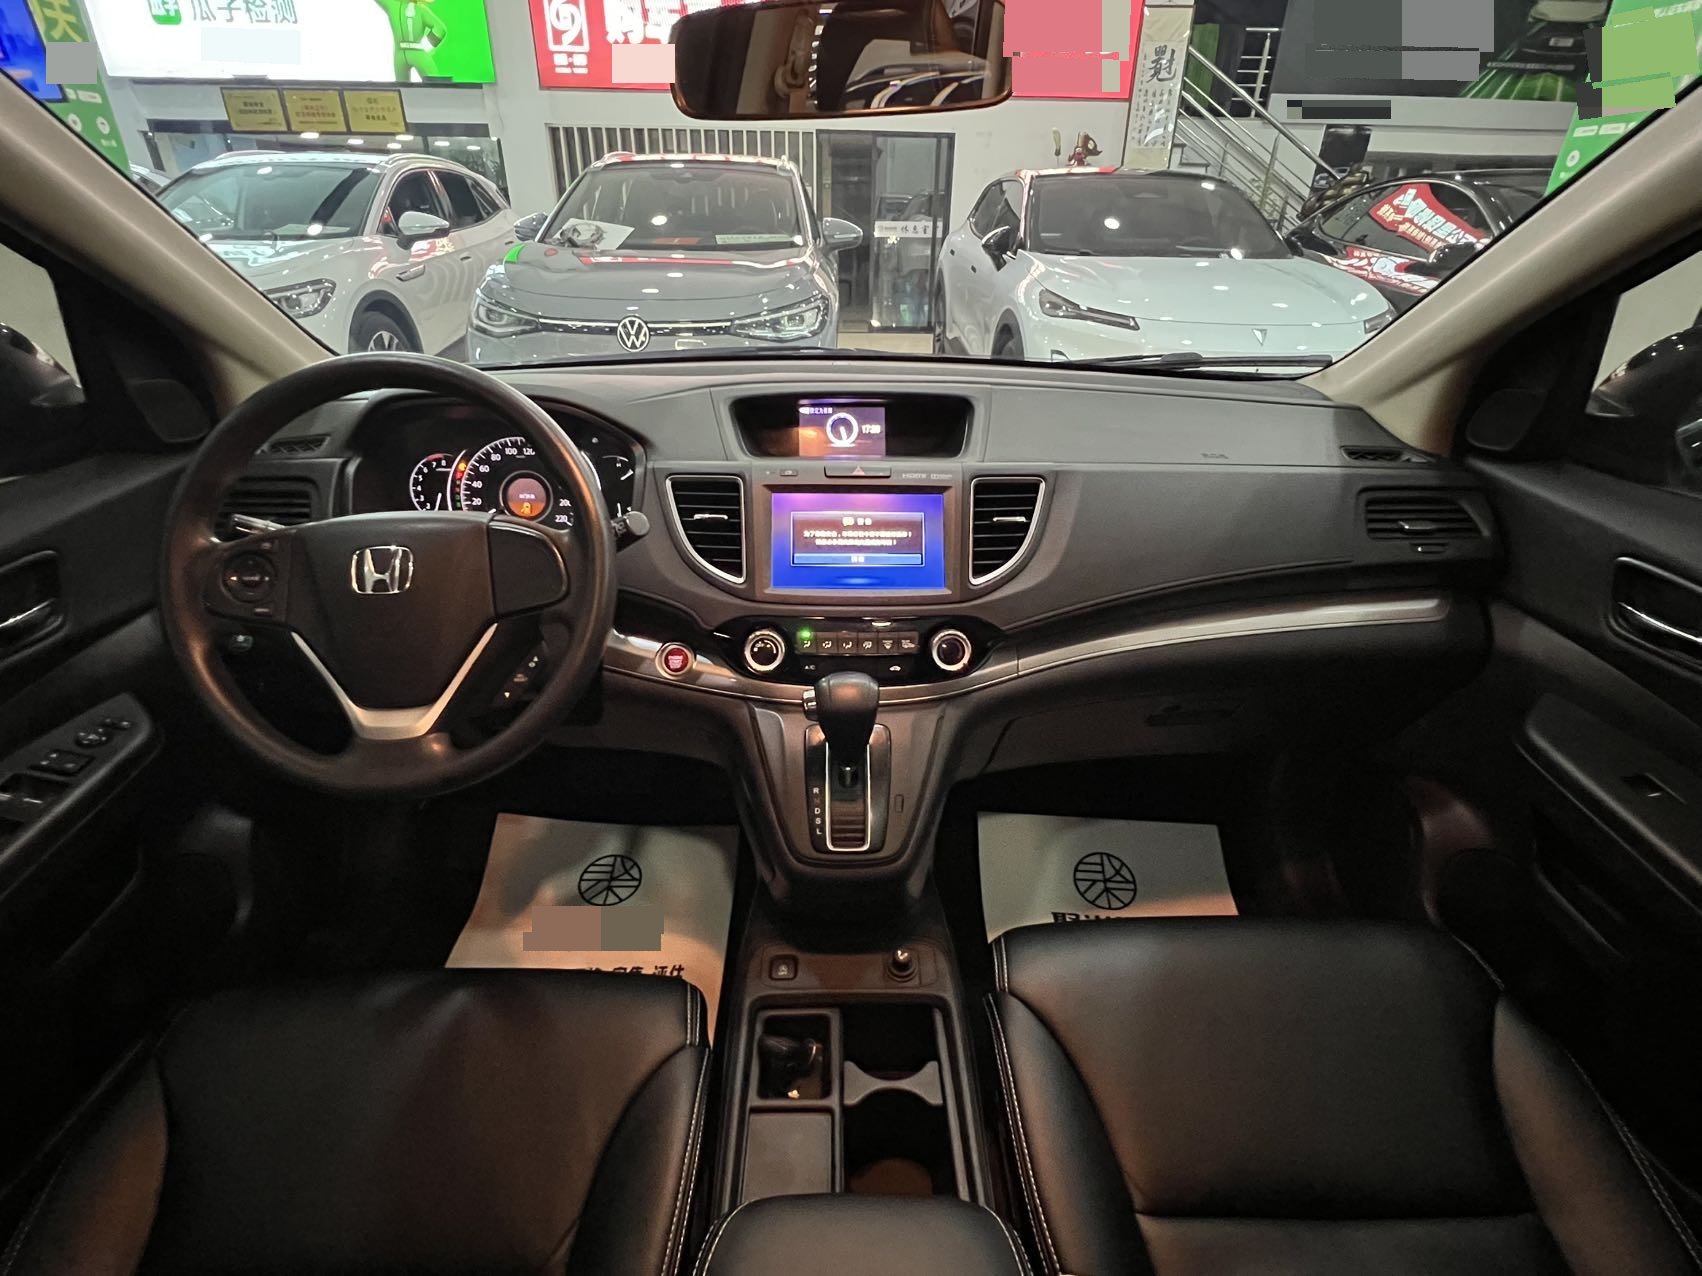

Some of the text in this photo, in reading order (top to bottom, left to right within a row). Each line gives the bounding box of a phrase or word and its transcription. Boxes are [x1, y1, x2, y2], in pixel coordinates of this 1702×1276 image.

[490, 453, 501, 461] 80
[479, 465, 490, 473] 60
[471, 480, 483, 489] 40
[471, 498, 482, 506] 20
[555, 514, 568, 523] 220
[814, 807, 821, 815] D
[815, 817, 822, 825] S
